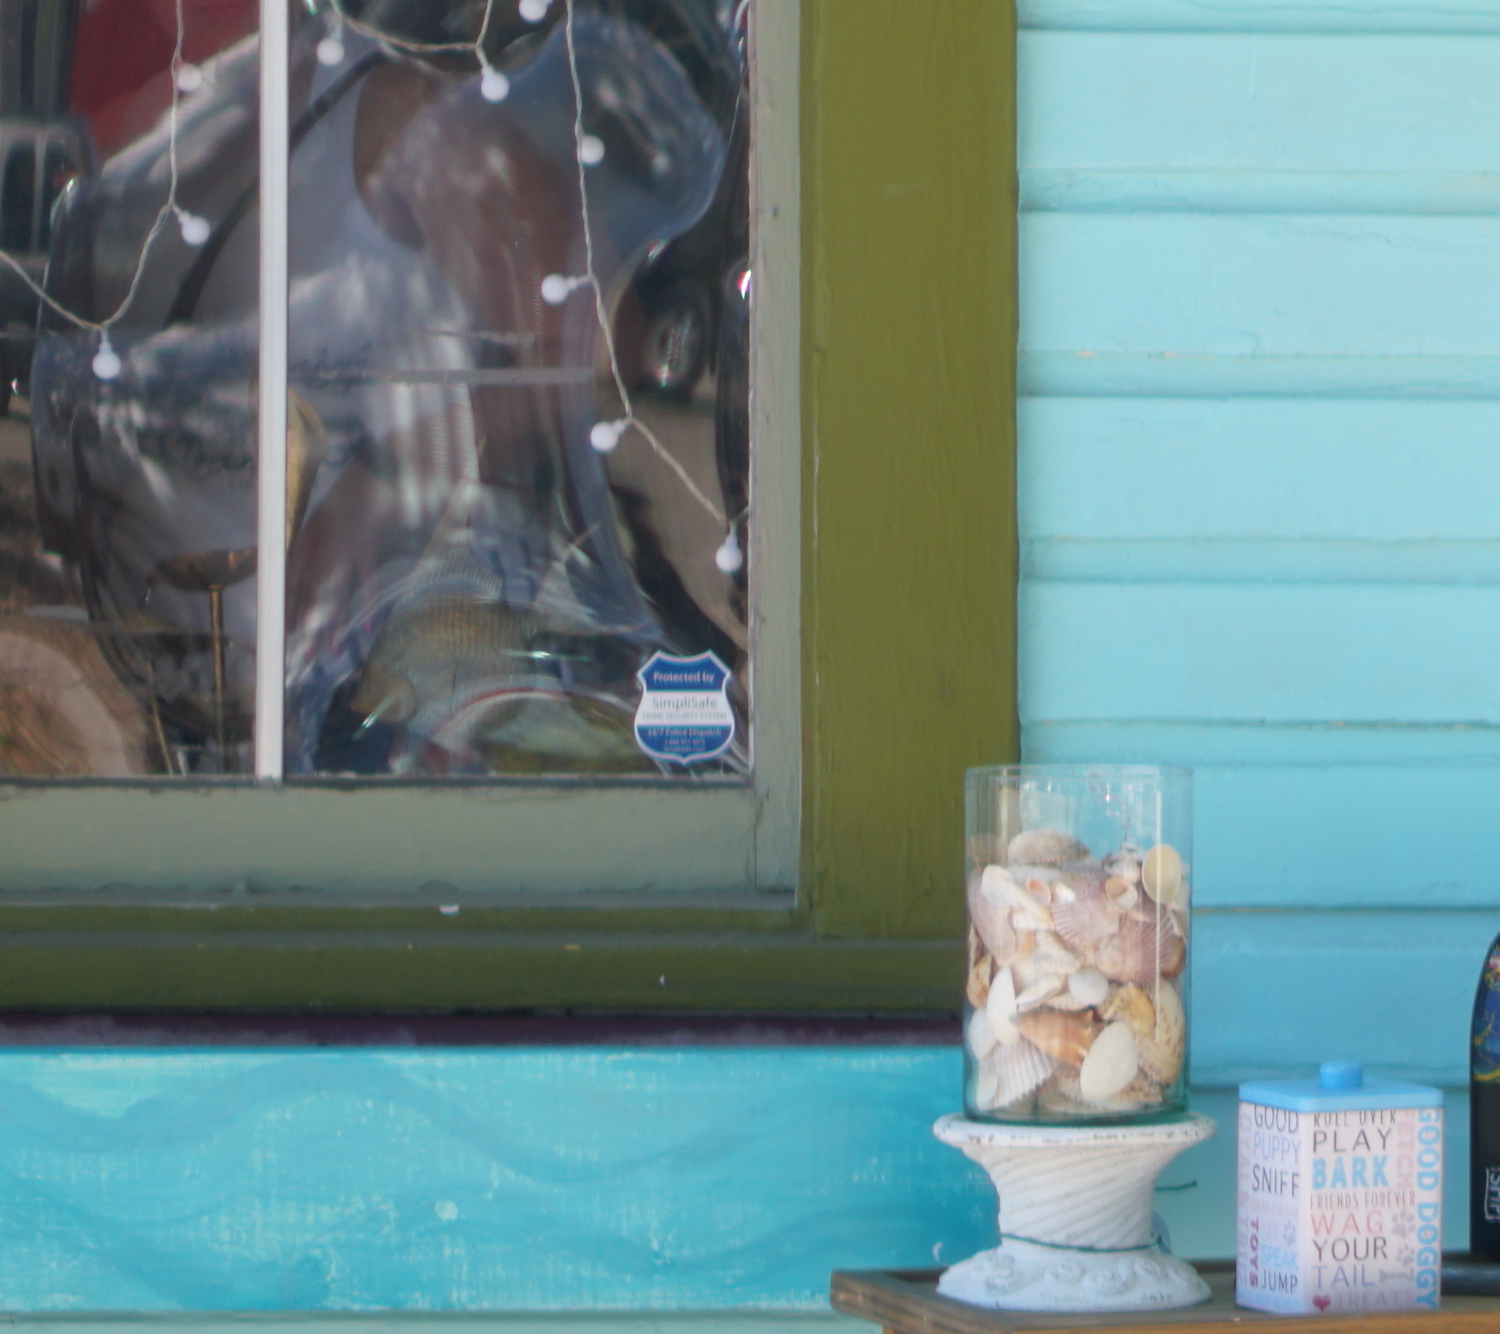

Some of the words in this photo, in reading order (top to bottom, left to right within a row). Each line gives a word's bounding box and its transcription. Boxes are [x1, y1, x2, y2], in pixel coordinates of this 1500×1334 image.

[653, 670, 701, 683] Protected
[702, 670, 715, 685] by
[652, 695, 717, 711] SimpliSafe
[1254, 1104, 1299, 1134] GOOD
[1239, 1114, 1251, 1183] OYAL
[1254, 1132, 1302, 1165] PUPPY
[1312, 1128, 1392, 1153] PLAY
[1416, 1109, 1441, 1192] GOOD
[1252, 1164, 1300, 1198] SNIFF
[1311, 1155, 1390, 1190] BARK
[1310, 1192, 1359, 1210] FRIENDS
[1365, 1190, 1416, 1209] FOREVER
[1311, 1210, 1384, 1236] WAG
[1250, 1217, 1259, 1287] TOYS
[1261, 1244, 1299, 1271] SPEAK
[1312, 1236, 1388, 1262] YOUR
[1415, 1202, 1440, 1309] DOGGY
[1261, 1269, 1298, 1294] JUMP
[1311, 1264, 1376, 1289] TAIL
